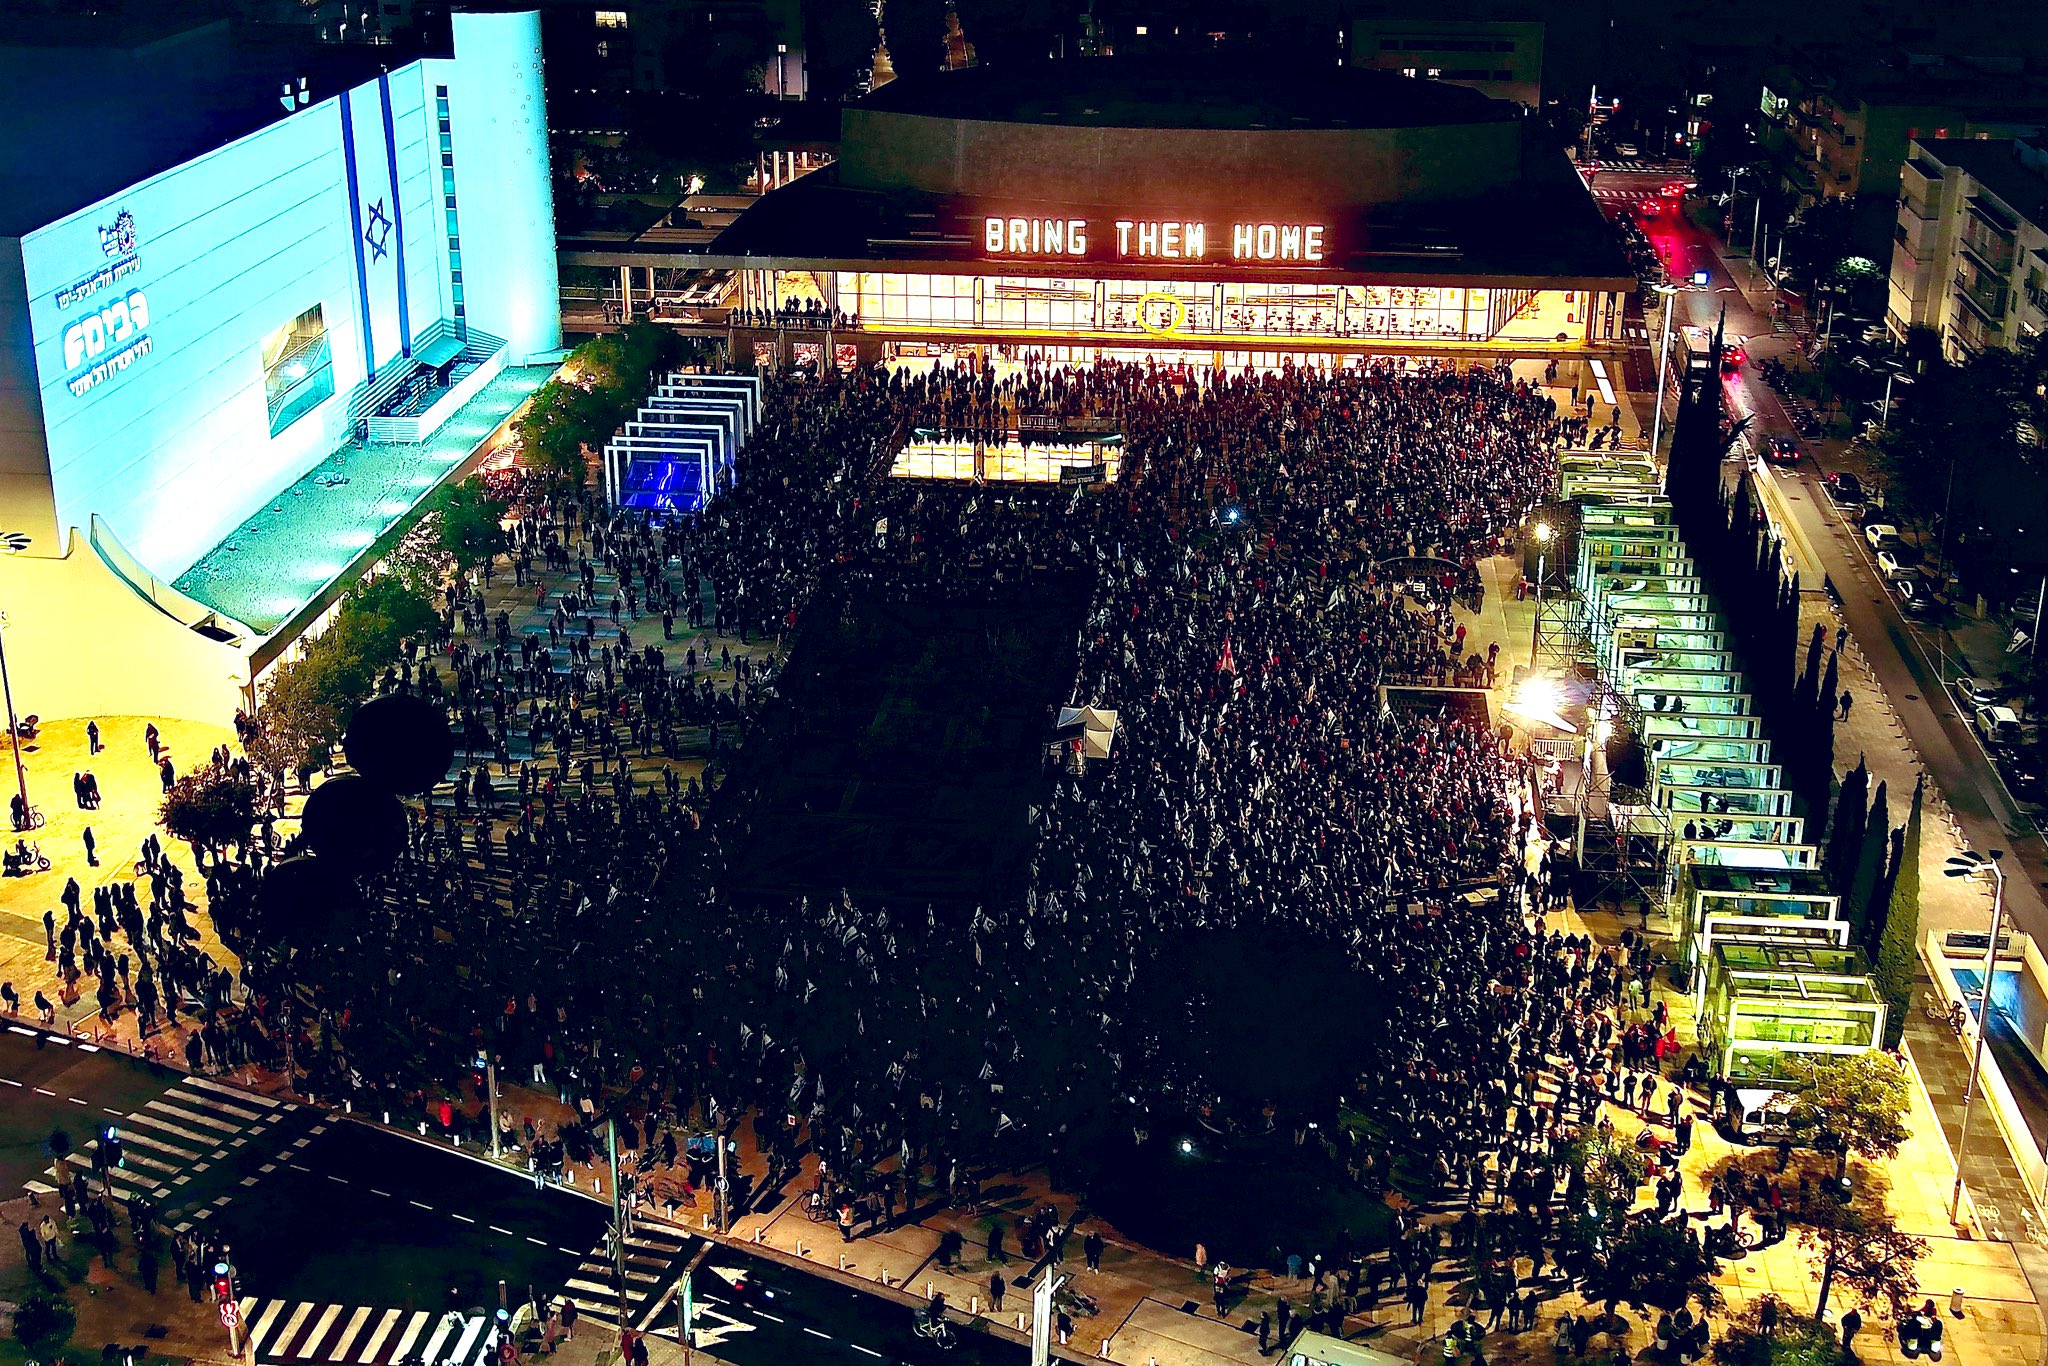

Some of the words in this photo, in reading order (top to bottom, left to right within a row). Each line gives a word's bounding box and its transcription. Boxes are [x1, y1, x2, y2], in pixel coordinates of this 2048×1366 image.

[984, 217, 1087, 256] BRING
[1115, 220, 1206, 259] THEM
[1232, 223, 1325, 261] HOME
[997, 267, 1041, 275] CHARLES
[1043, 268, 1093, 277] BRONFMAN
[1093, 269, 1147, 279] AUDITORIUM
[62, 288, 150, 371] הבימה
